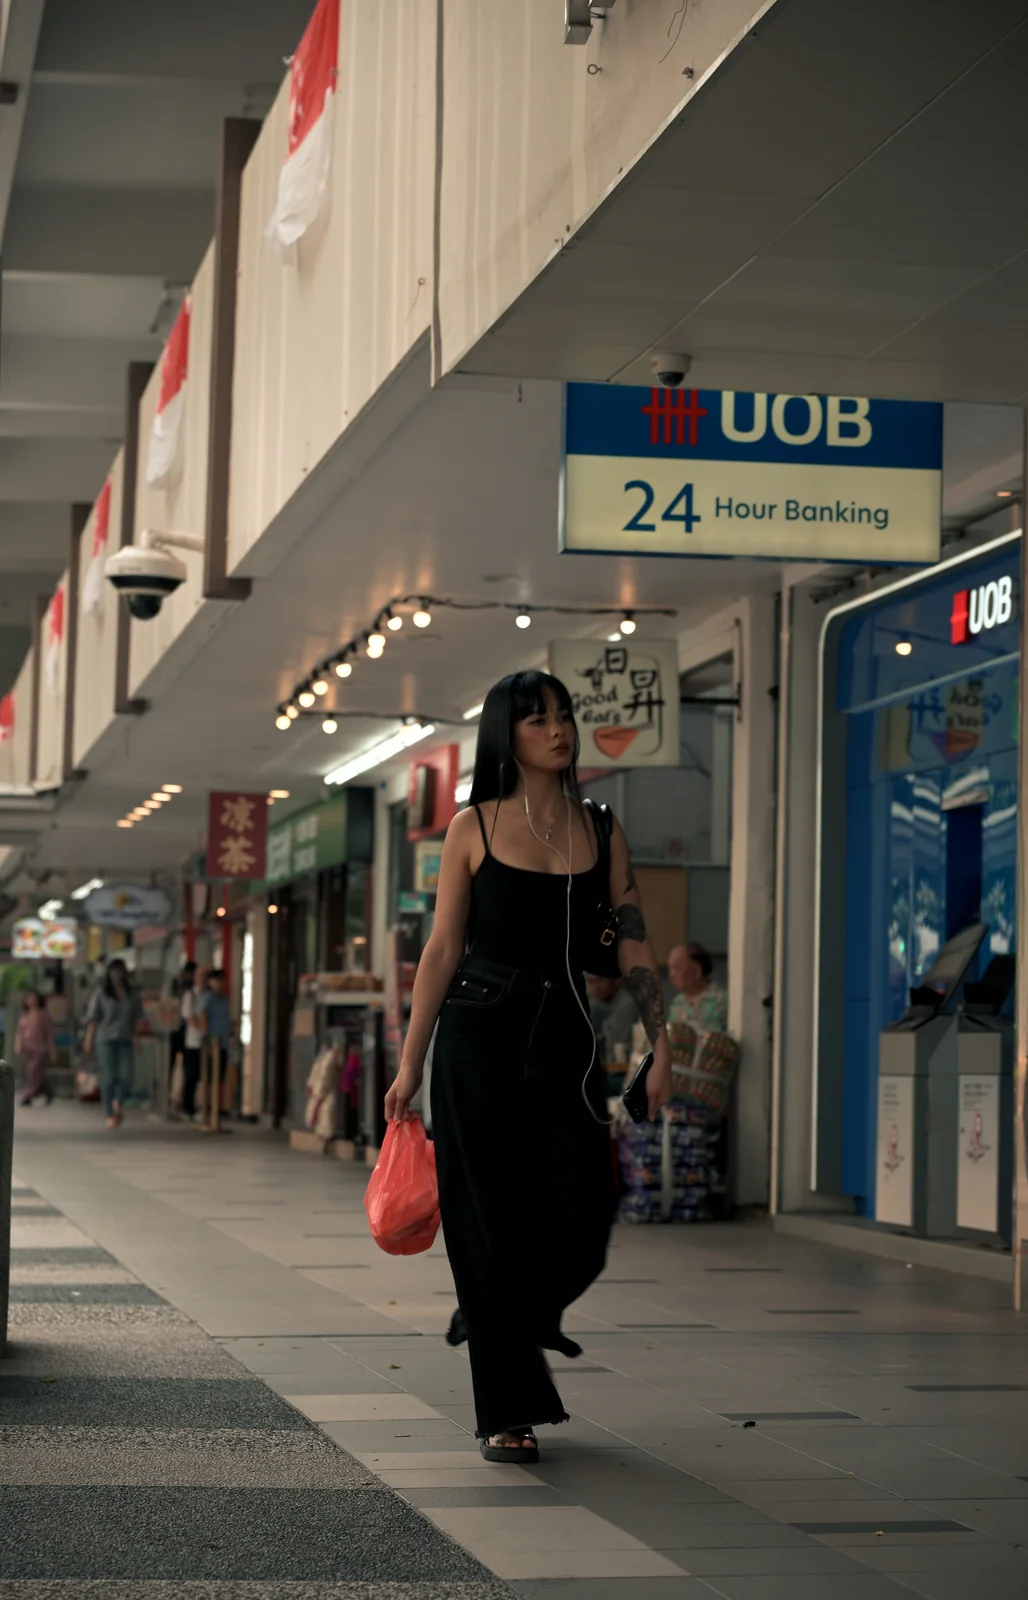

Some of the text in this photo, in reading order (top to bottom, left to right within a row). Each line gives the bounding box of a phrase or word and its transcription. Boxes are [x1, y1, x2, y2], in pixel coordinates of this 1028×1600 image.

[721, 390, 873, 447] UOB
[622, 480, 889, 533] 24 Hour Banking
[969, 575, 1012, 634] UOB
